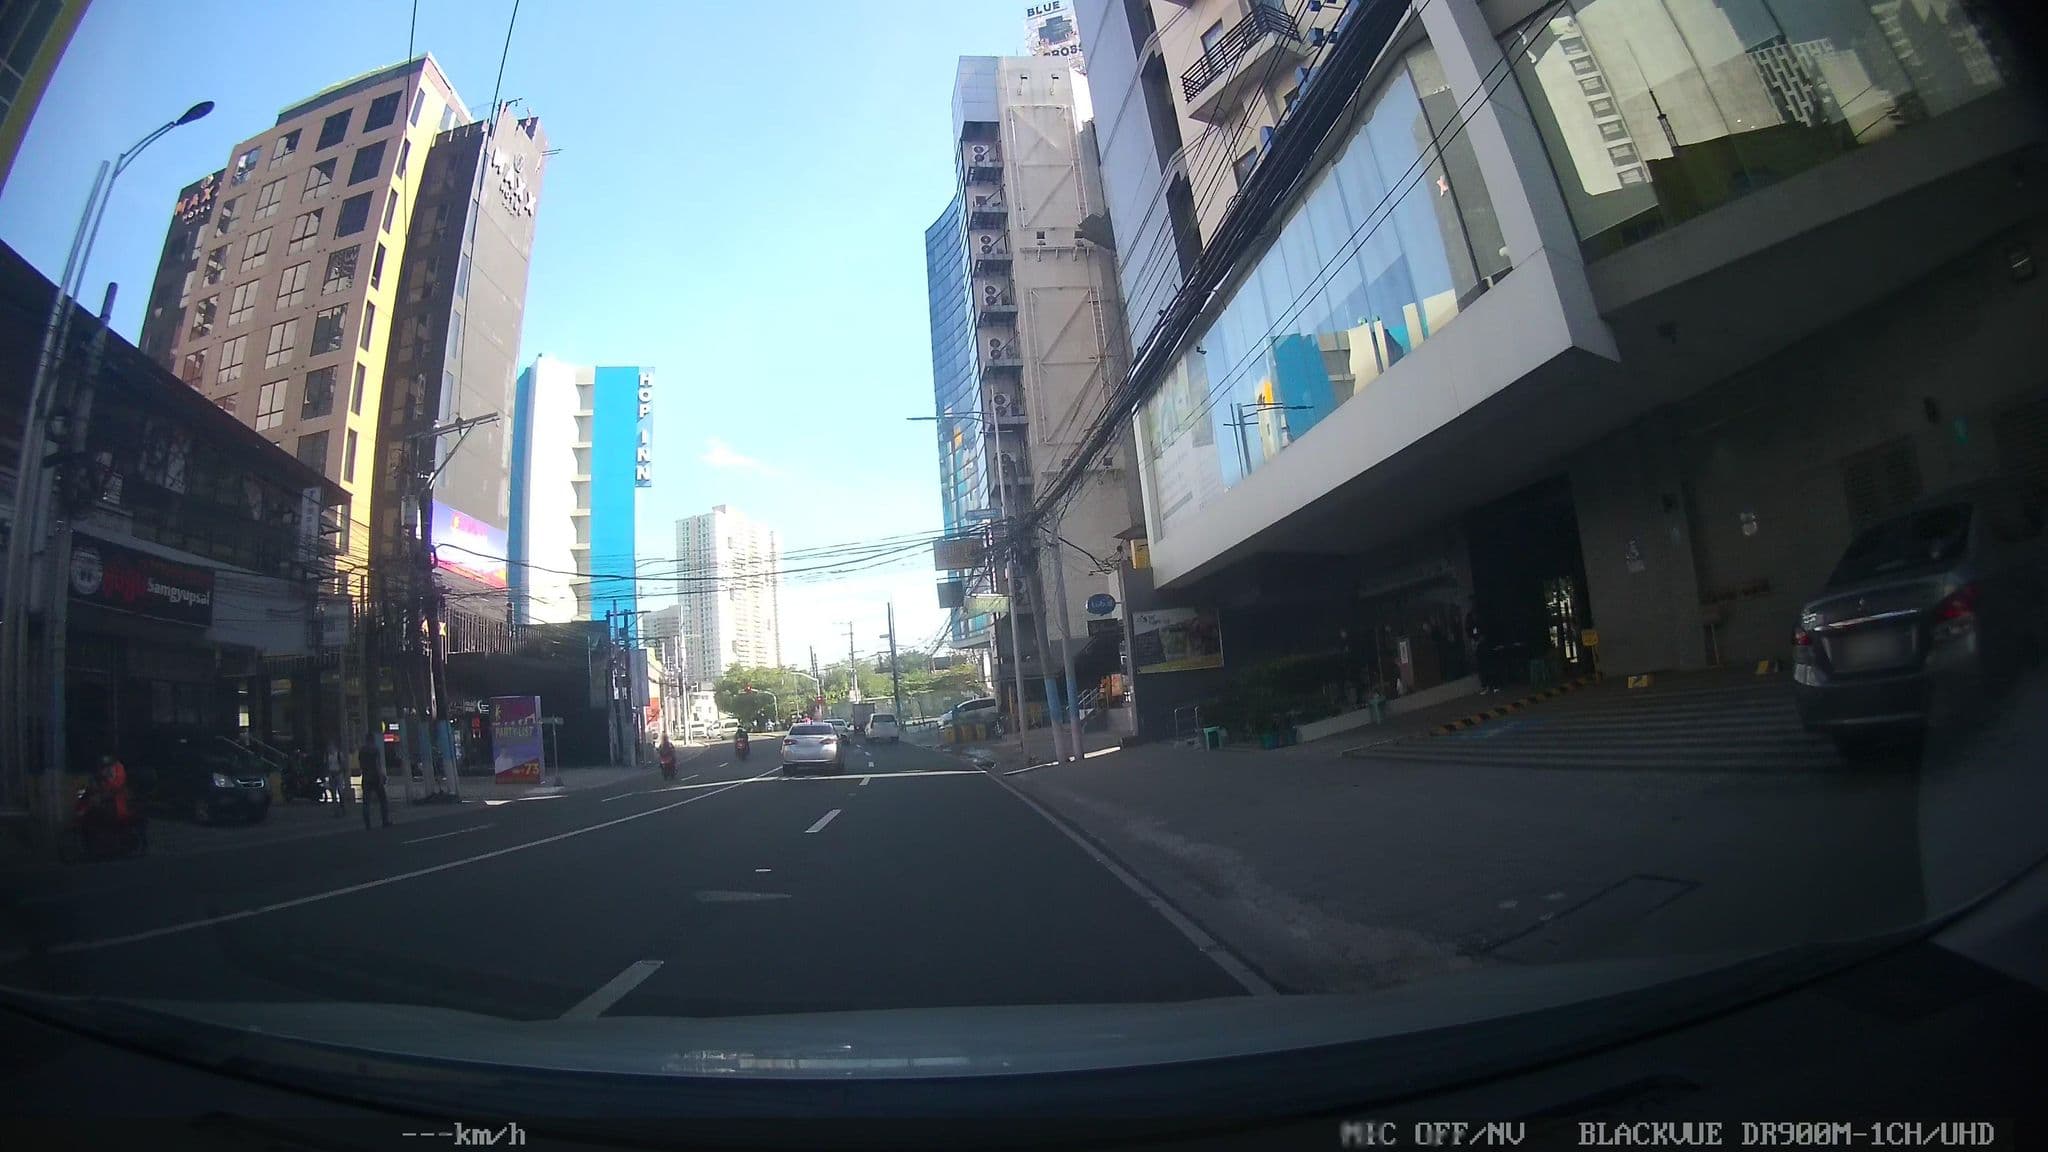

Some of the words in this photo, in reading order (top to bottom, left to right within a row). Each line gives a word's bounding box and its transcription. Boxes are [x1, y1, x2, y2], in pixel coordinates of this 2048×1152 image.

[1027, 1, 1060, 17] BLUE
[638, 373, 654, 420] HOP
[636, 430, 652, 481] INN
[146, 576, 211, 607] Samgyupsal
